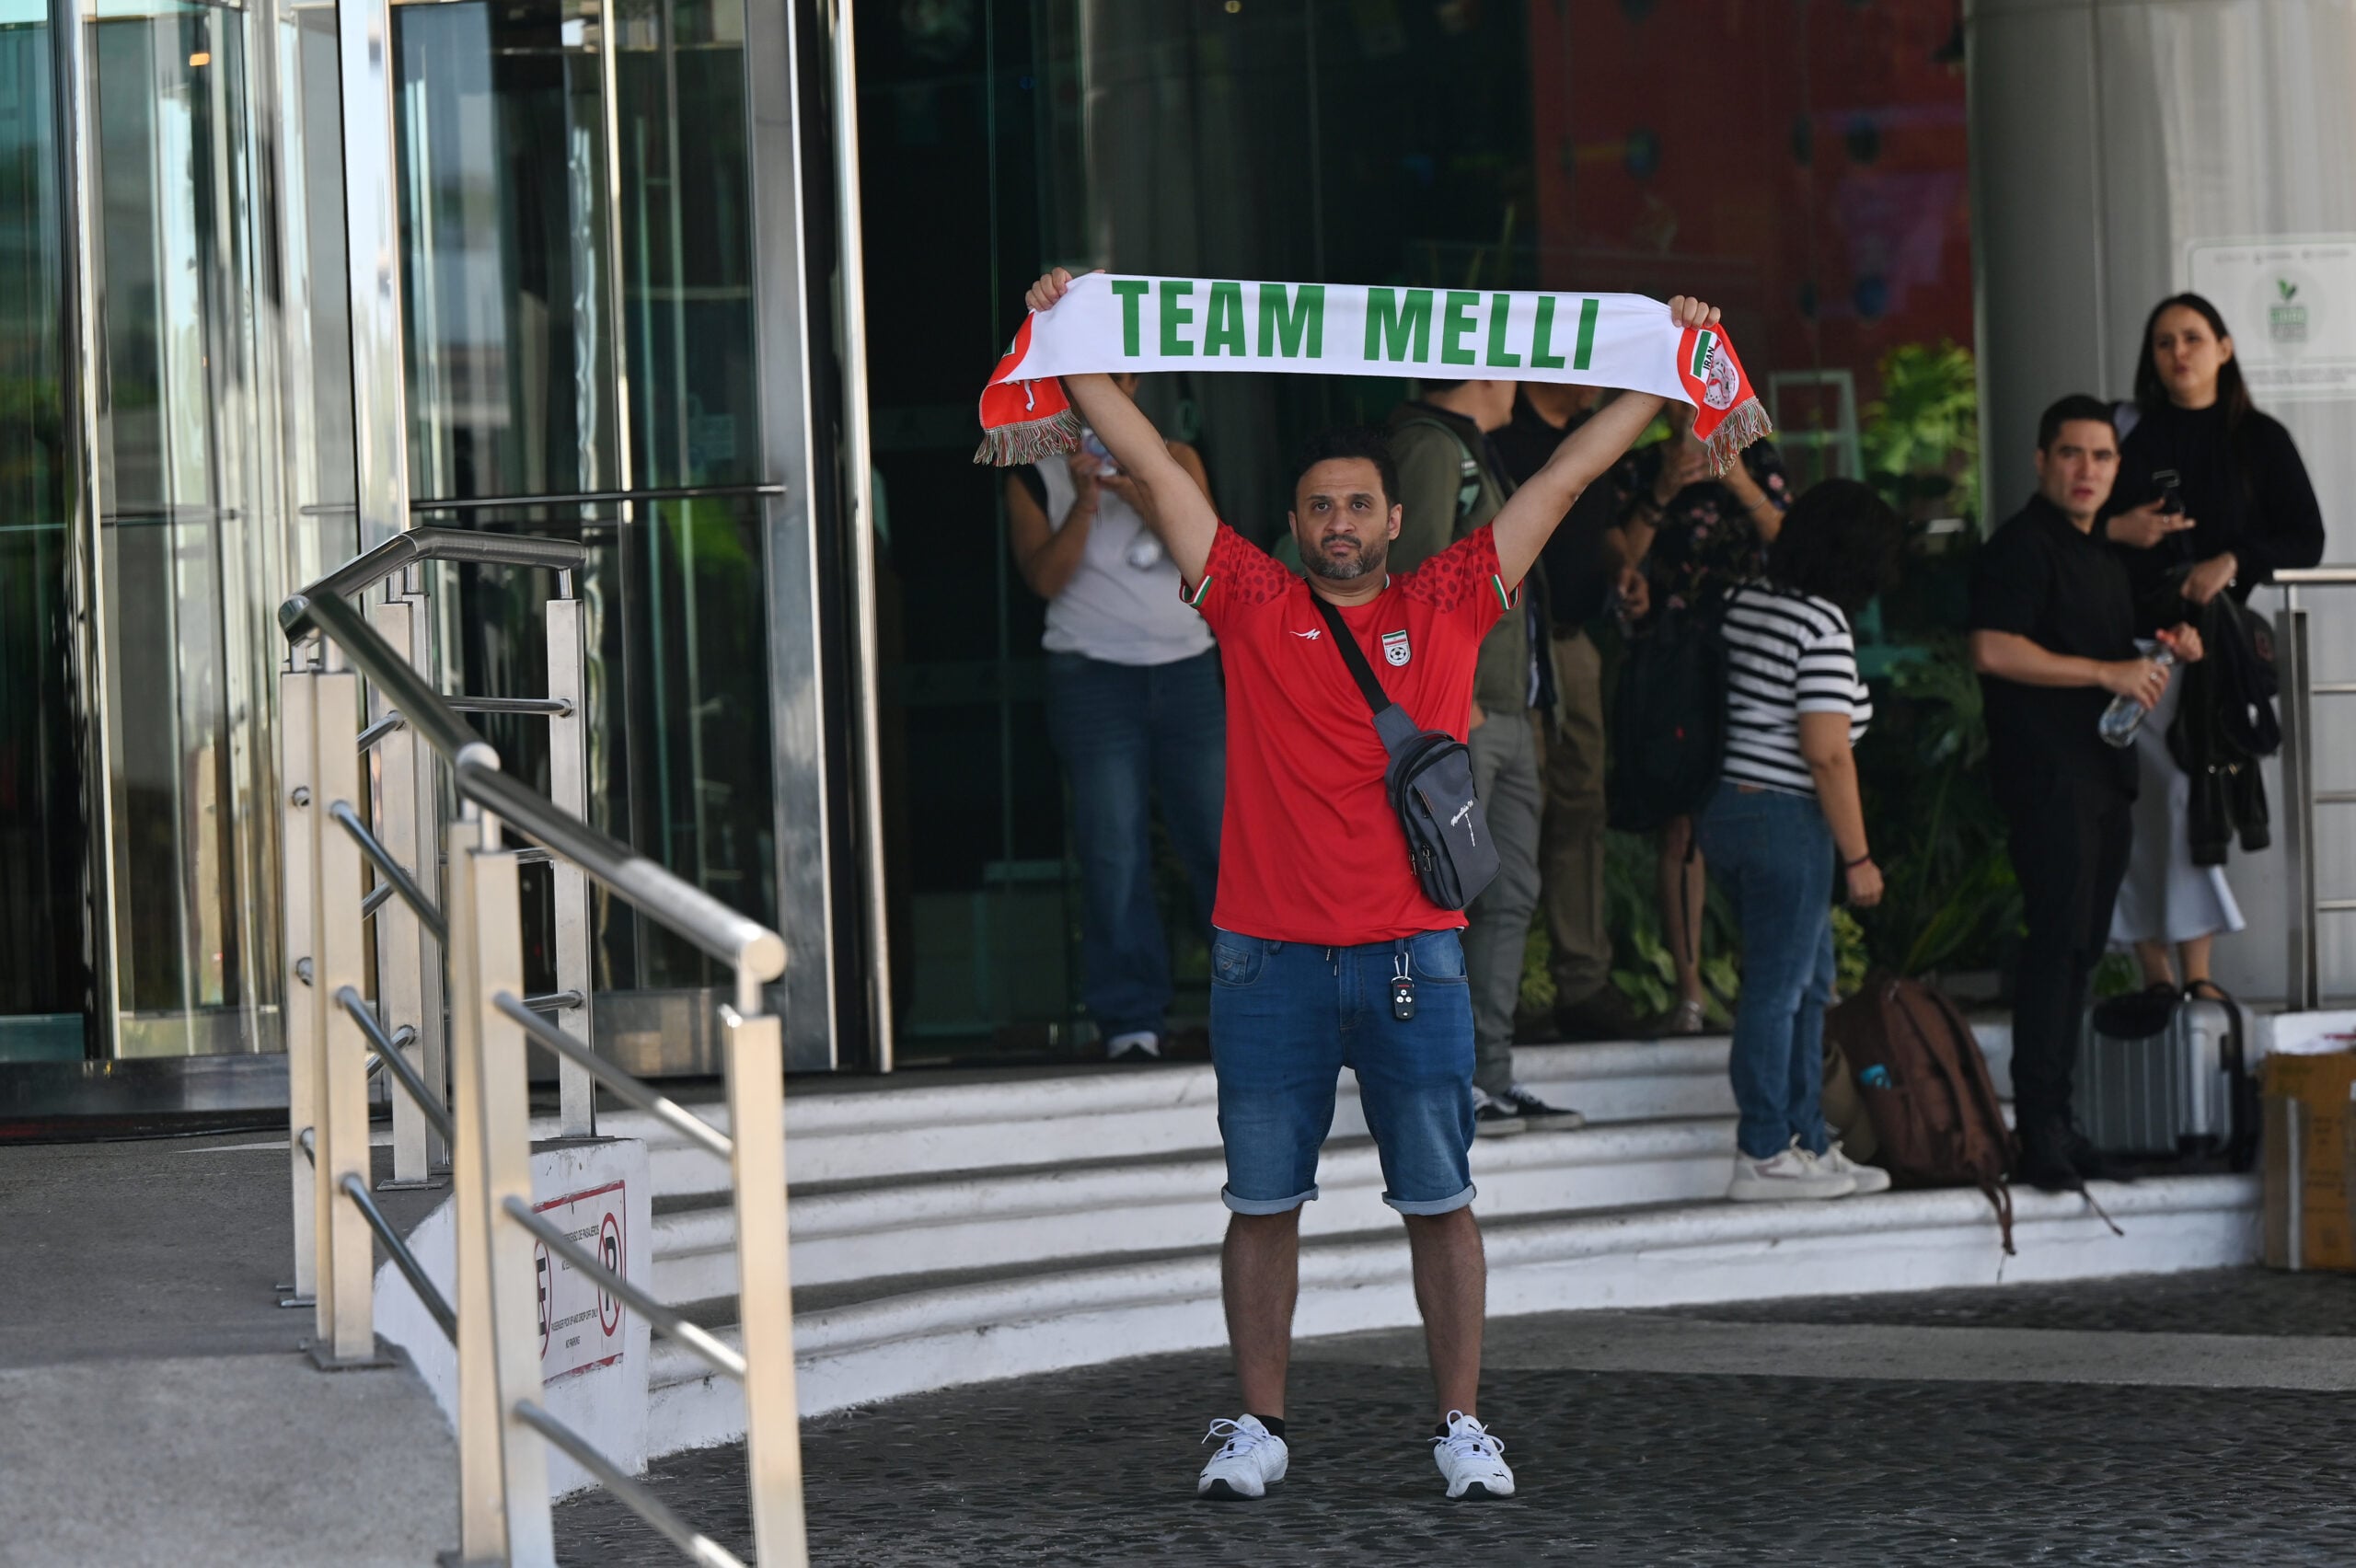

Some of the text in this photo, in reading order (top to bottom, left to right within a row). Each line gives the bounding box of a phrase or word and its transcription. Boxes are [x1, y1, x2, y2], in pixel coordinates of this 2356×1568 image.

[1112, 281, 1599, 369] TEAM MELLI
[1703, 346, 1715, 371] IRAN
